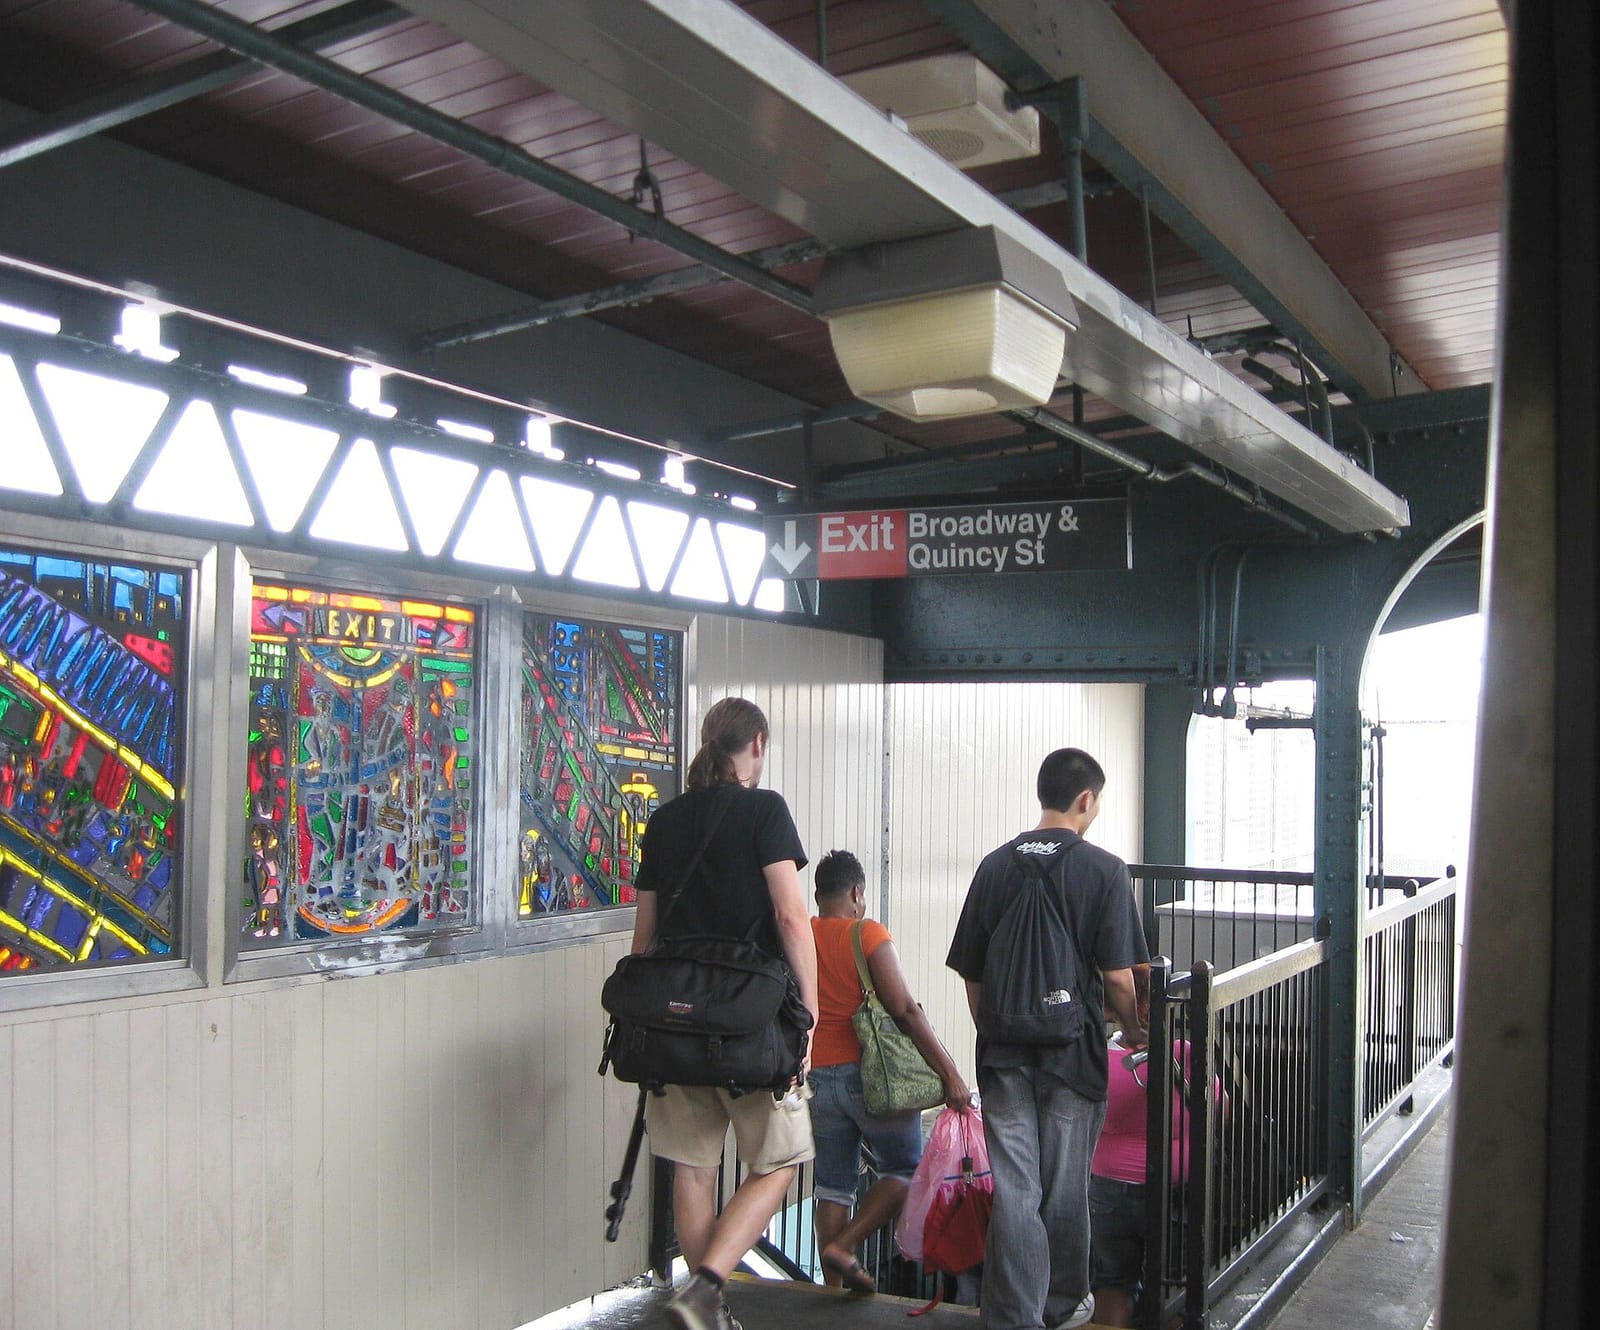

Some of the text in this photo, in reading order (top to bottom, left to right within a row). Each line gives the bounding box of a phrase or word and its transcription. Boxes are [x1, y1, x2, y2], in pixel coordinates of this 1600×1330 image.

[821, 515, 895, 553] Exit
[909, 505, 1080, 539] Broadway &
[908, 538, 1045, 573] Quincy St
[328, 609, 395, 640] EXIT
